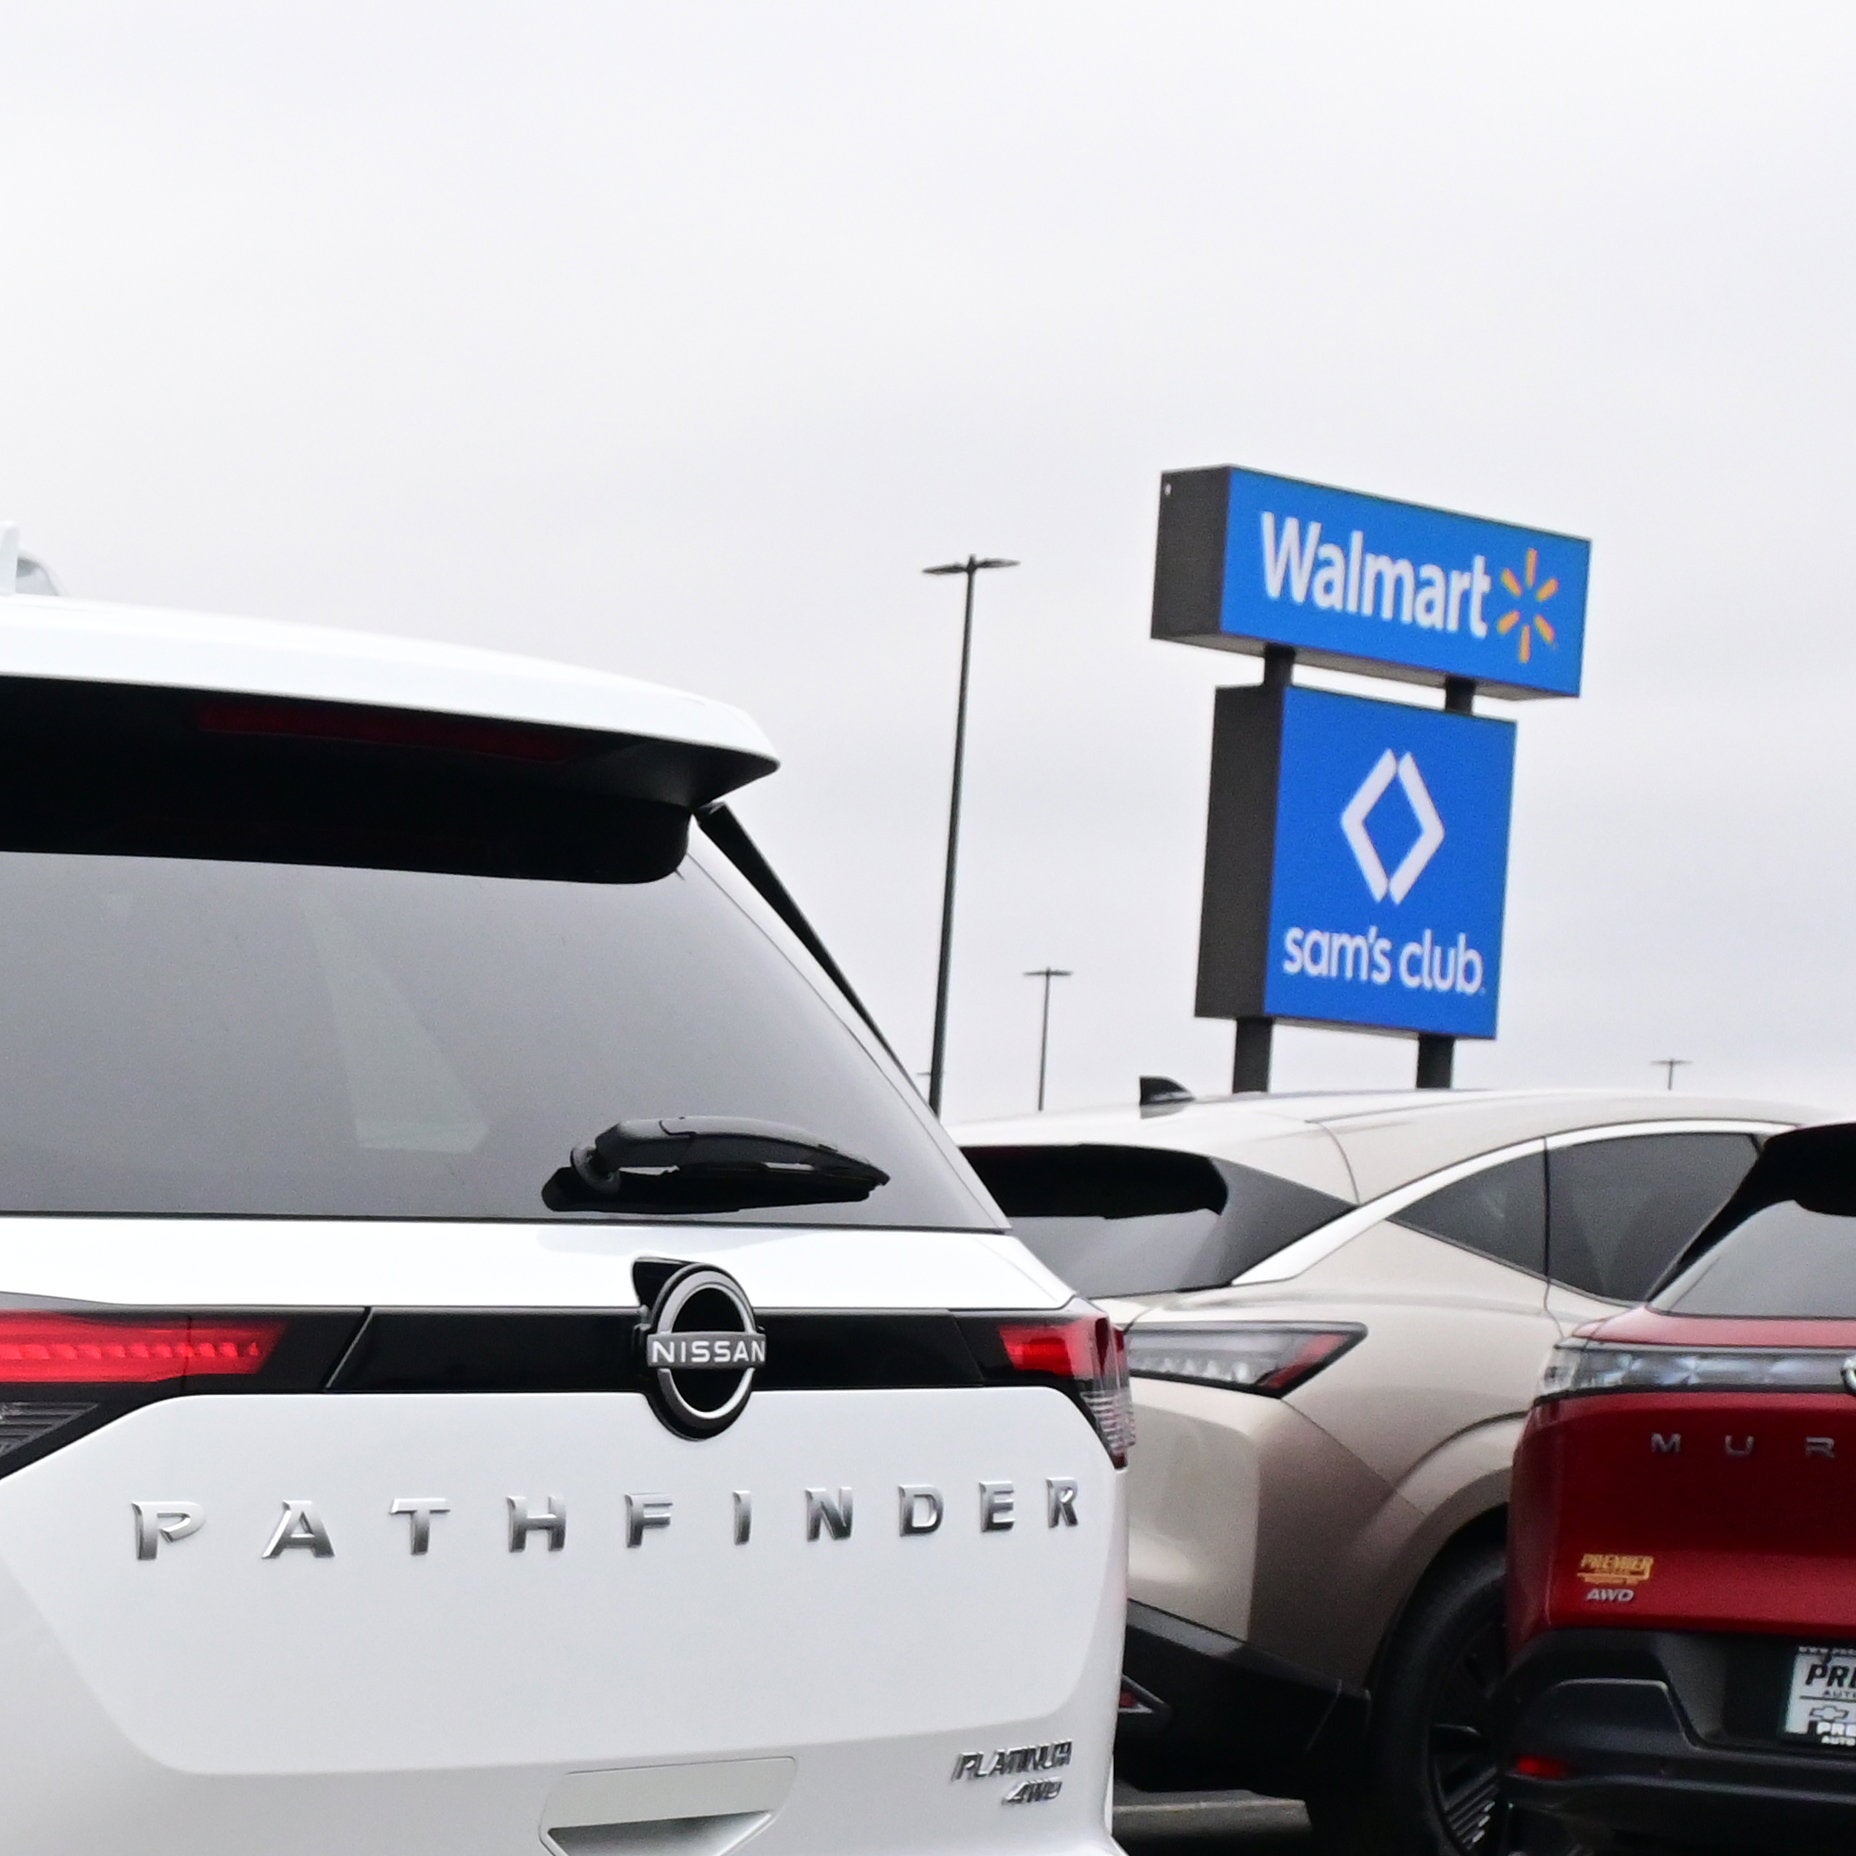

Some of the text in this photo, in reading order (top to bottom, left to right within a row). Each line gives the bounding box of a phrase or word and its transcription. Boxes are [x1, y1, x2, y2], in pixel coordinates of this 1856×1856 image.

[1261, 511, 1492, 638] Walmart
[1283, 925, 1484, 995] sam's club
[652, 1340, 766, 1363] NISSAN
[130, 1475, 1081, 1561] PATHFINDER
[1587, 1588, 1634, 1602] AWD
[951, 1739, 1073, 1781] PLATINUM
[1001, 1777, 1063, 1805] 4WD
